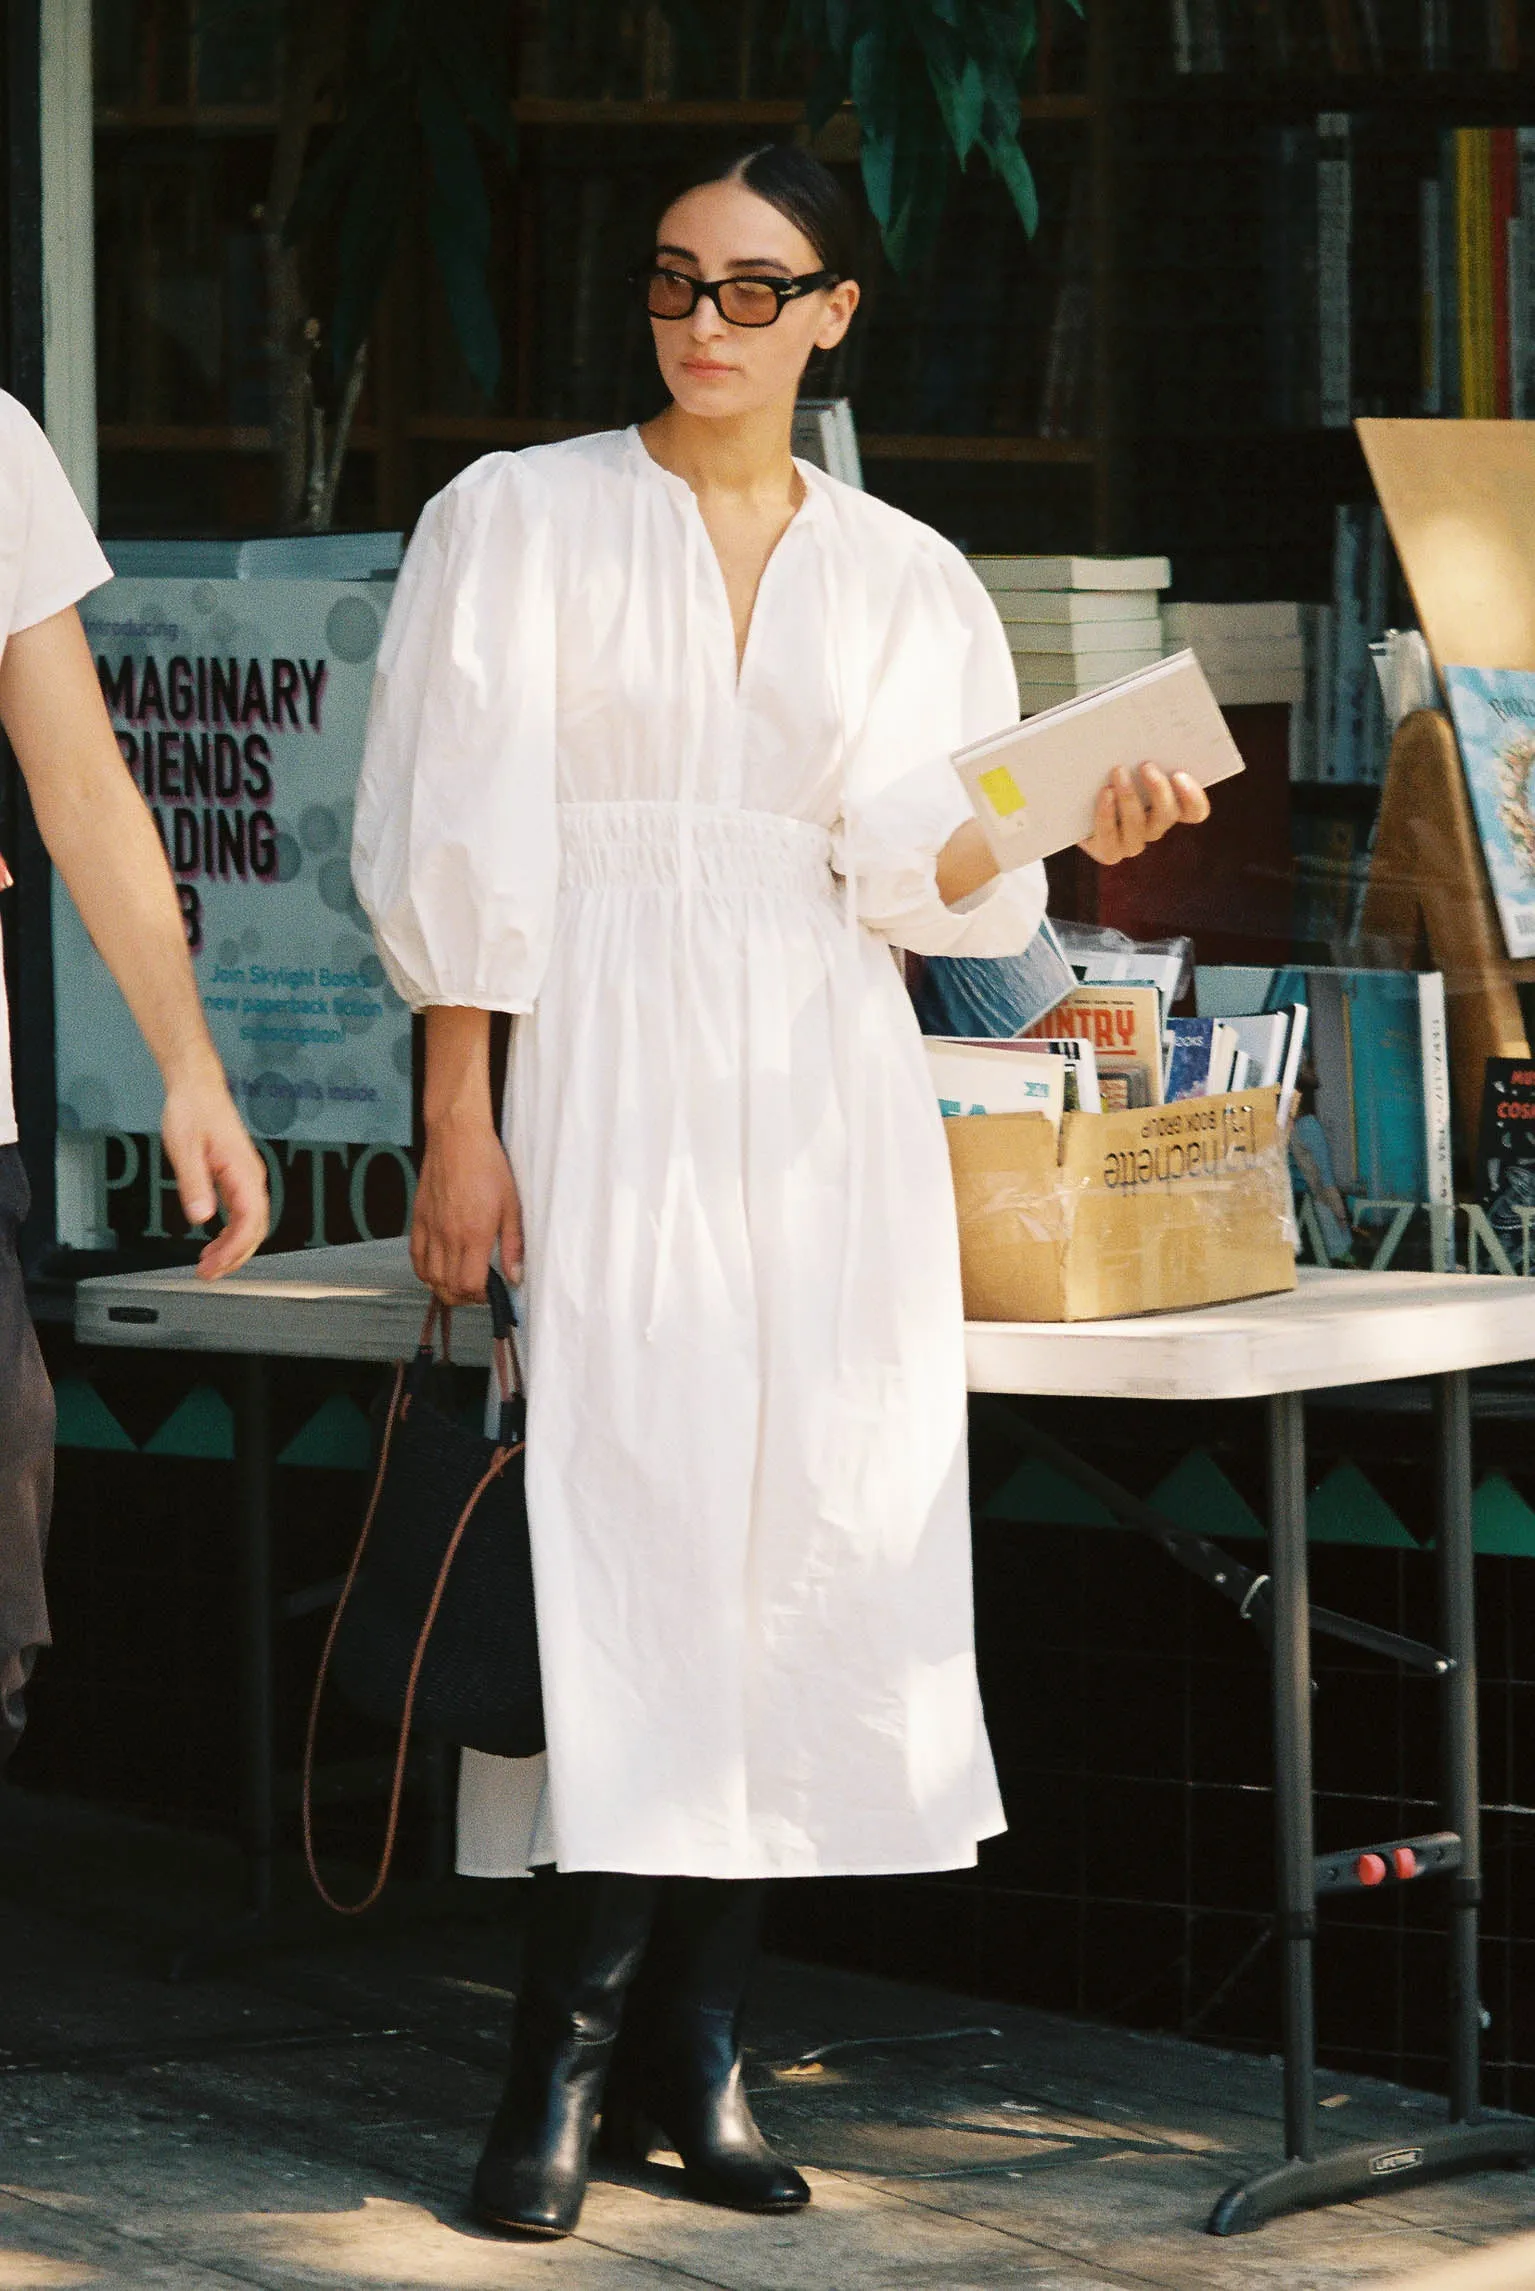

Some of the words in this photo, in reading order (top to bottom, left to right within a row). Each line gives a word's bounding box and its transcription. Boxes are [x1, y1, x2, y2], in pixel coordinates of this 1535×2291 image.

[93, 654, 326, 727] MAGINARY
[114, 730, 273, 800] IENDS
[152, 806, 279, 880] DING
[249, 964, 315, 990] Skylight
[319, 967, 370, 988] Books
